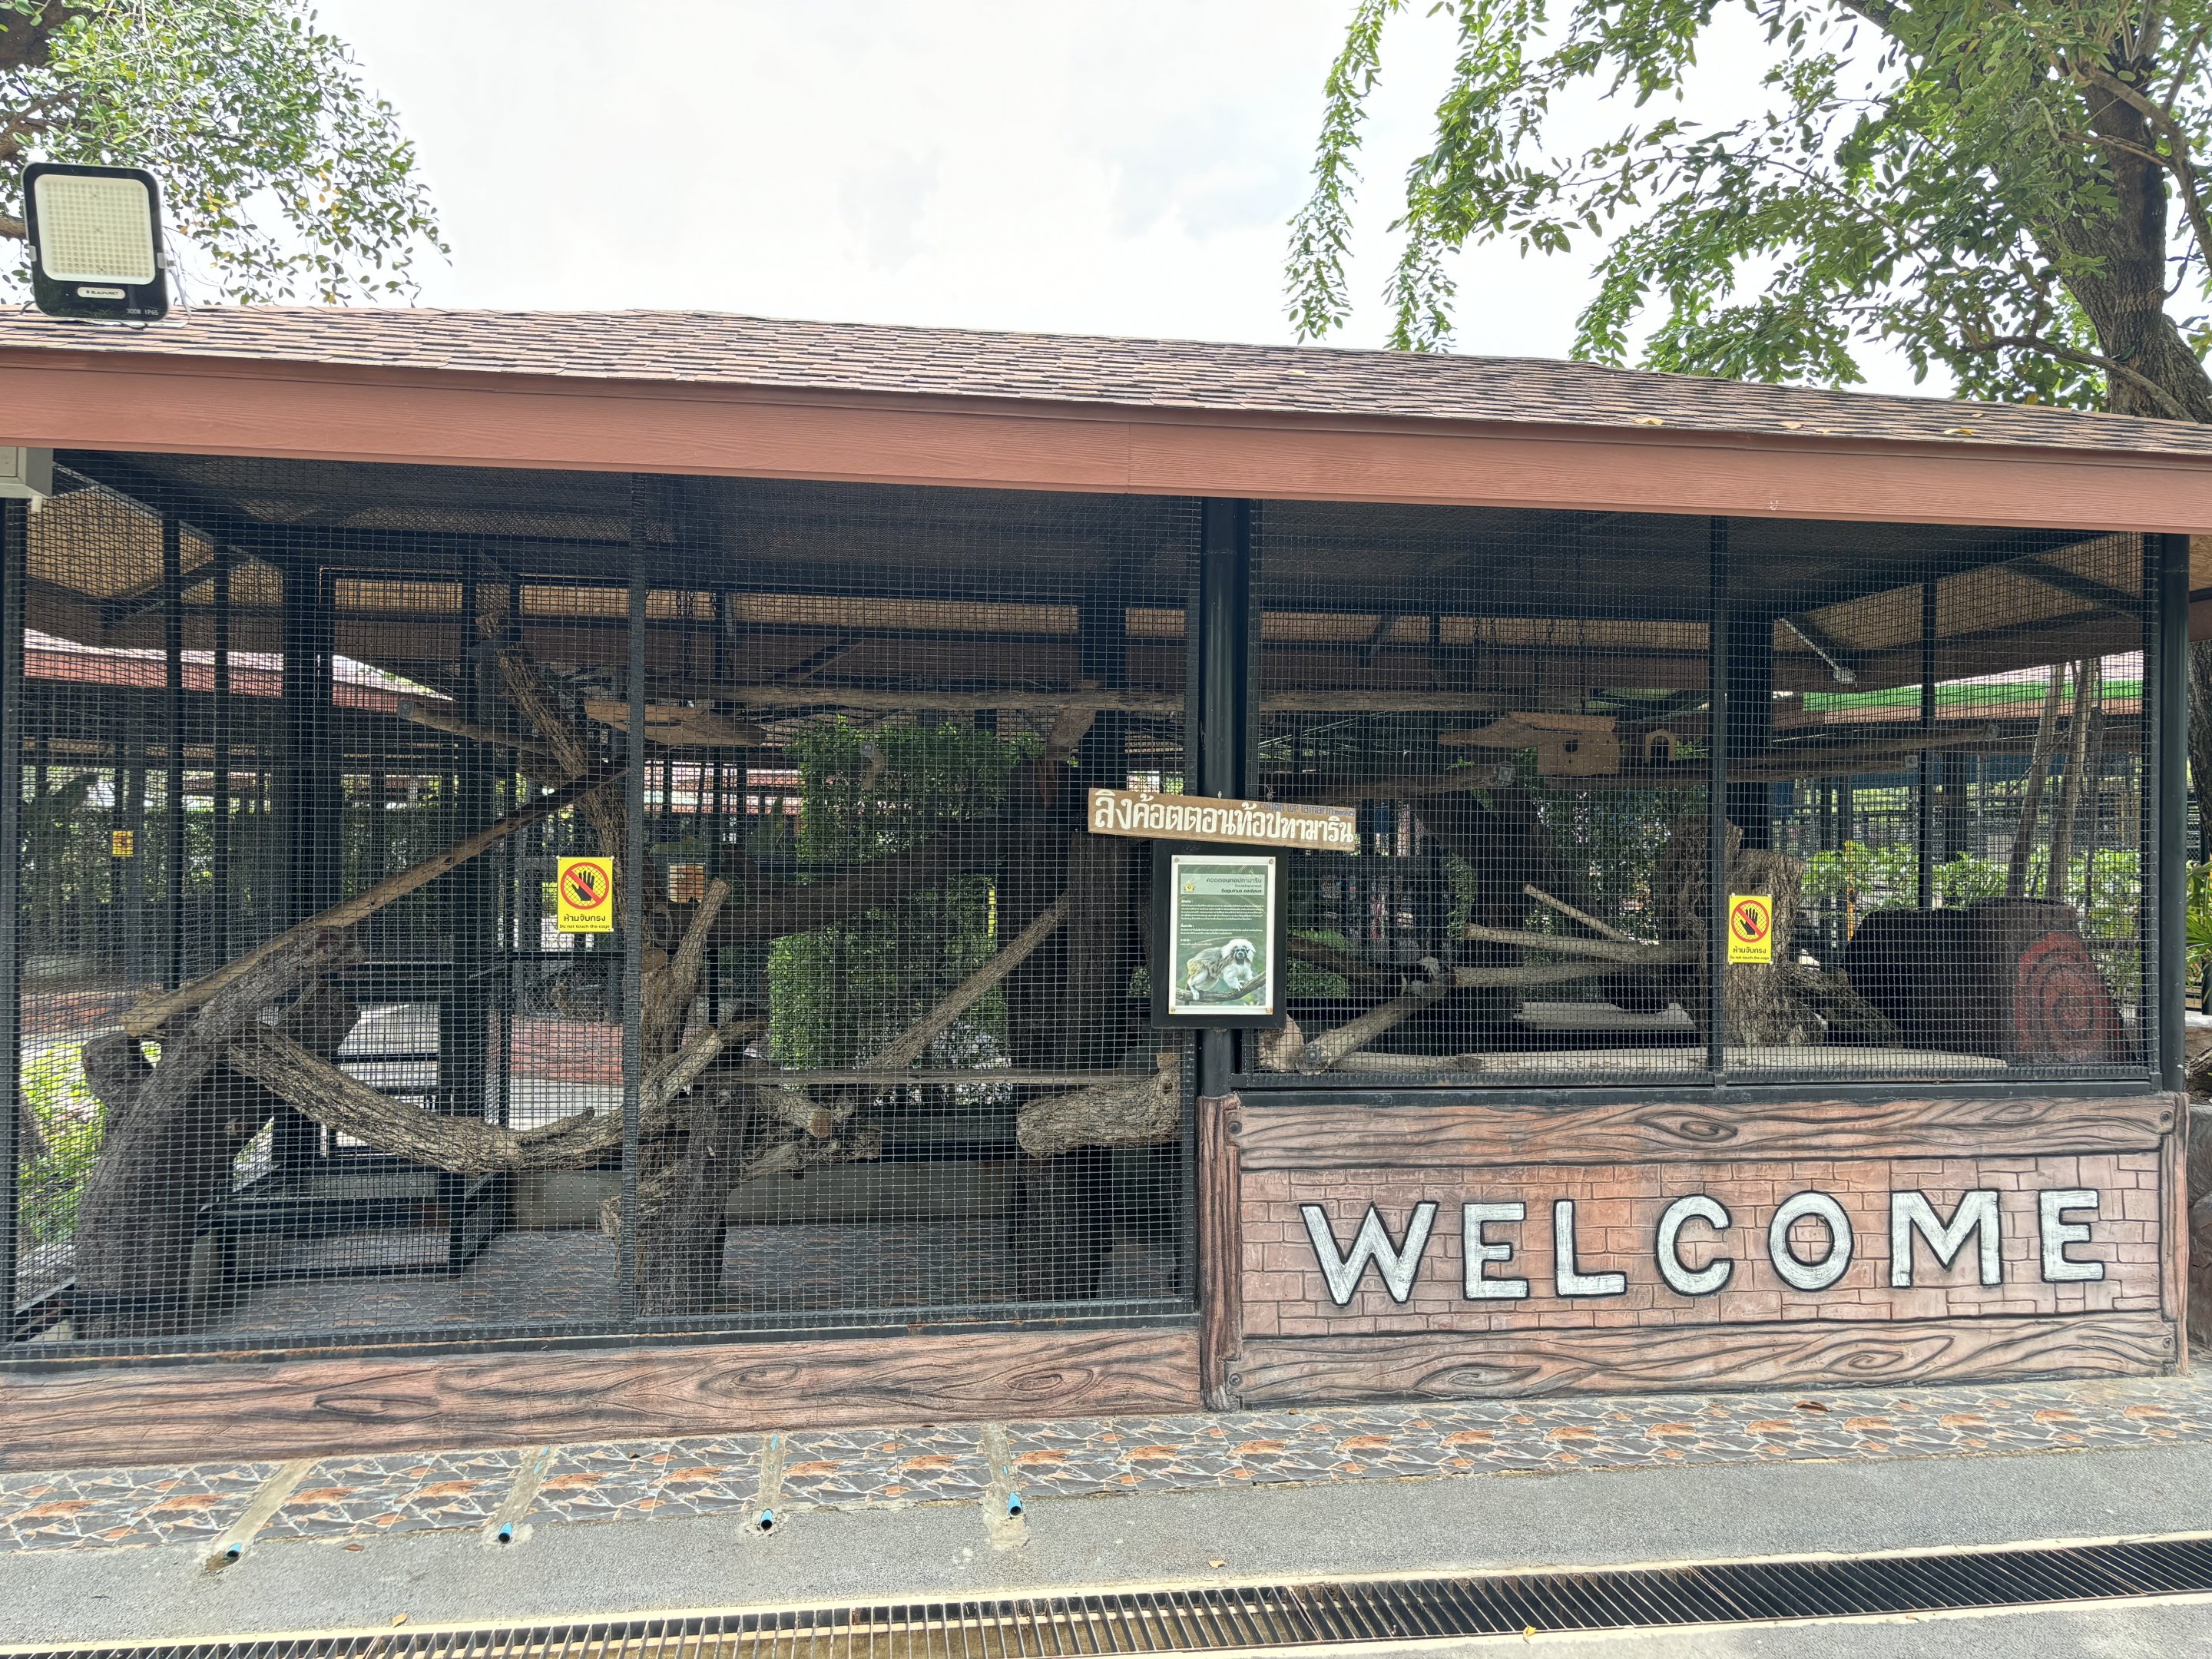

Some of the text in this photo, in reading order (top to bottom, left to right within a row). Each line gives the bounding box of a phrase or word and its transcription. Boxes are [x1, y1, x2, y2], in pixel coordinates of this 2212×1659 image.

[1094, 789, 1354, 843] ลิงค้อตตอนท้อปทามาริน
[1299, 1187, 2106, 1307] WELCOME
